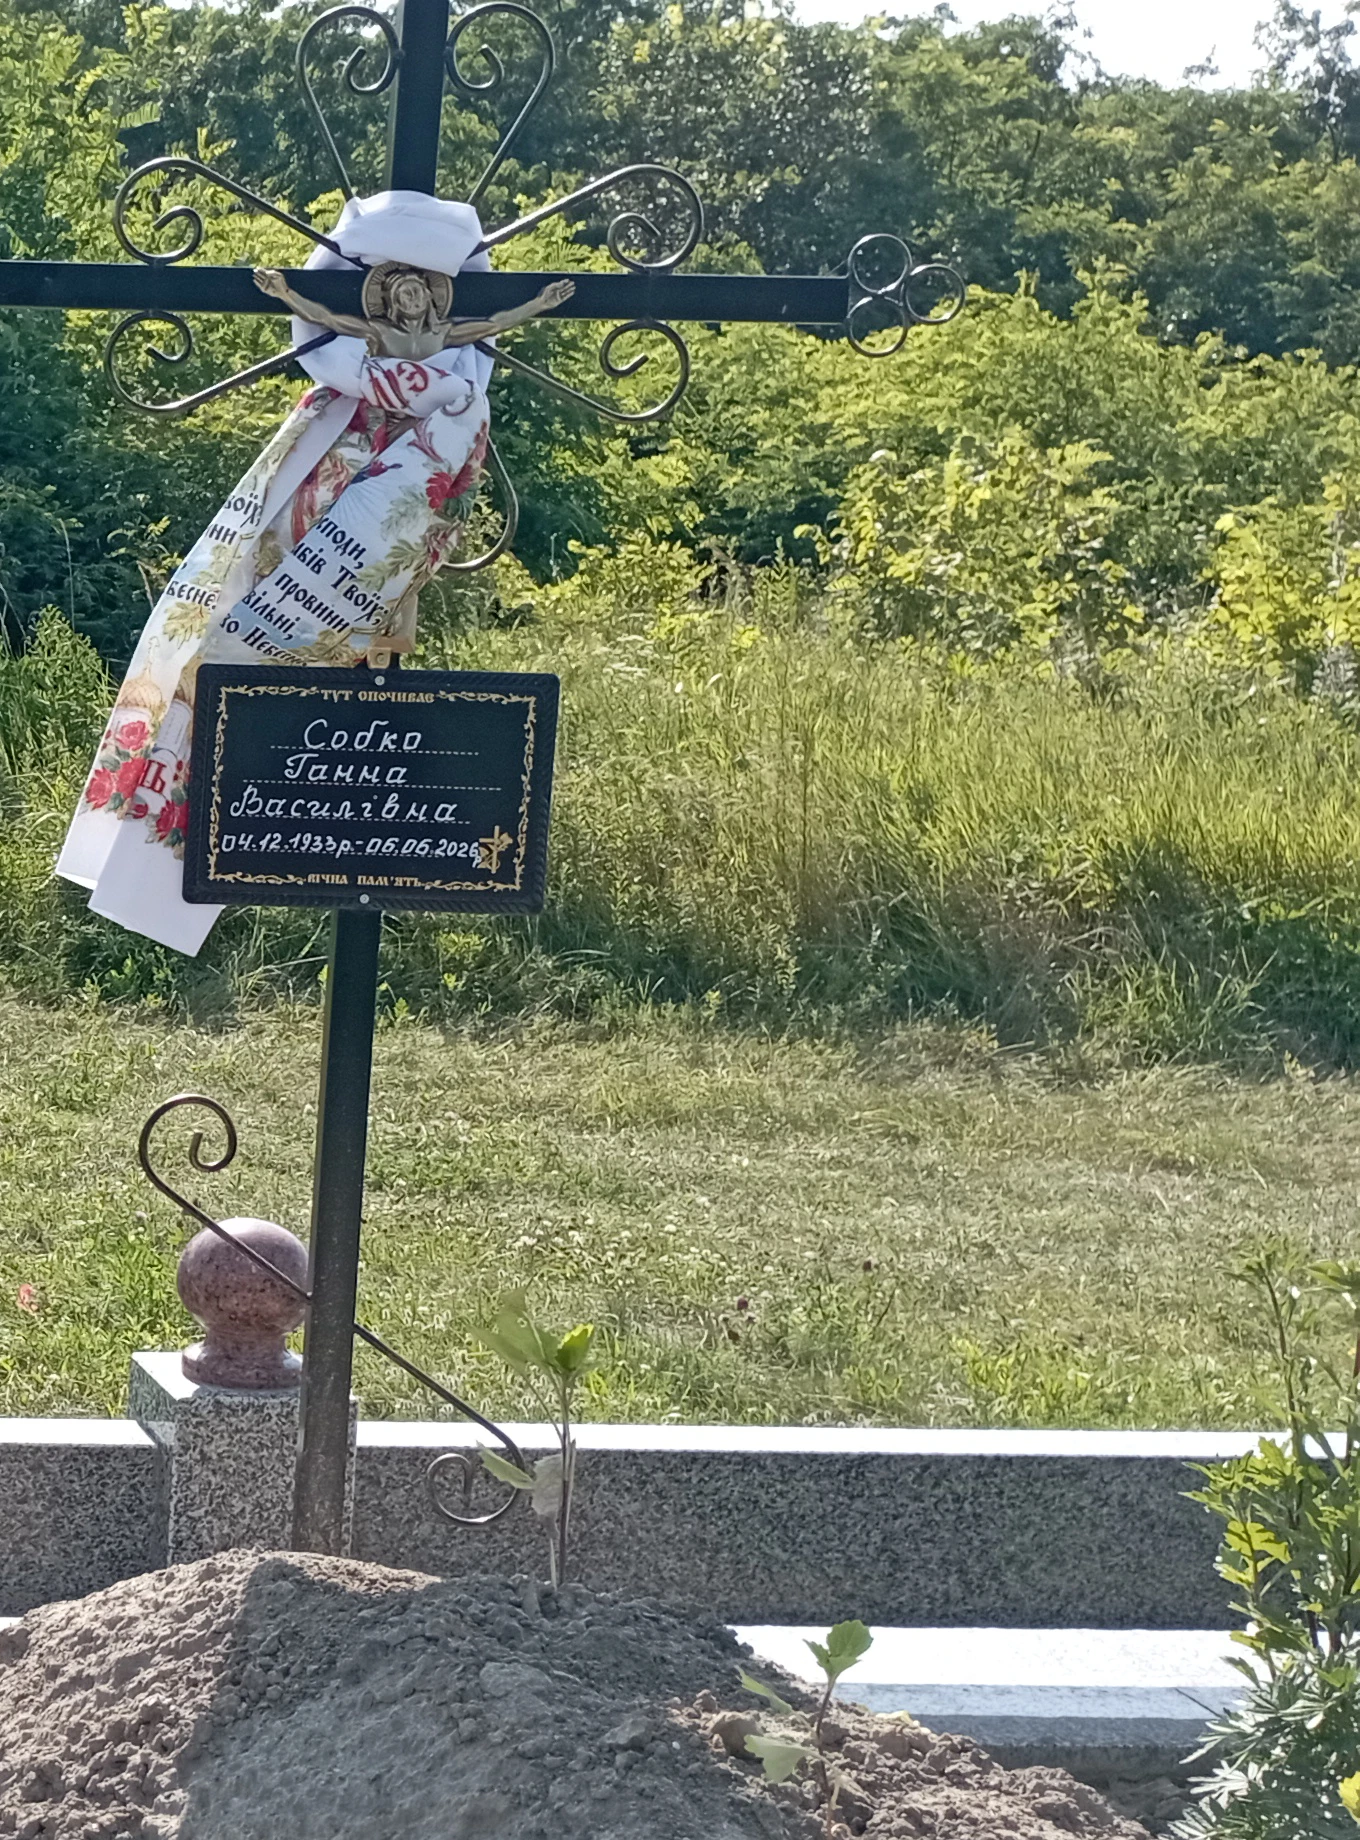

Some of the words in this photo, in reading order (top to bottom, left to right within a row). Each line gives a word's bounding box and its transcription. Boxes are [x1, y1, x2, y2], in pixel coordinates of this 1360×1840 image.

[321, 689, 354, 703] ТУТ
[303, 718, 423, 751] Собко
[283, 753, 408, 785] Ганна
